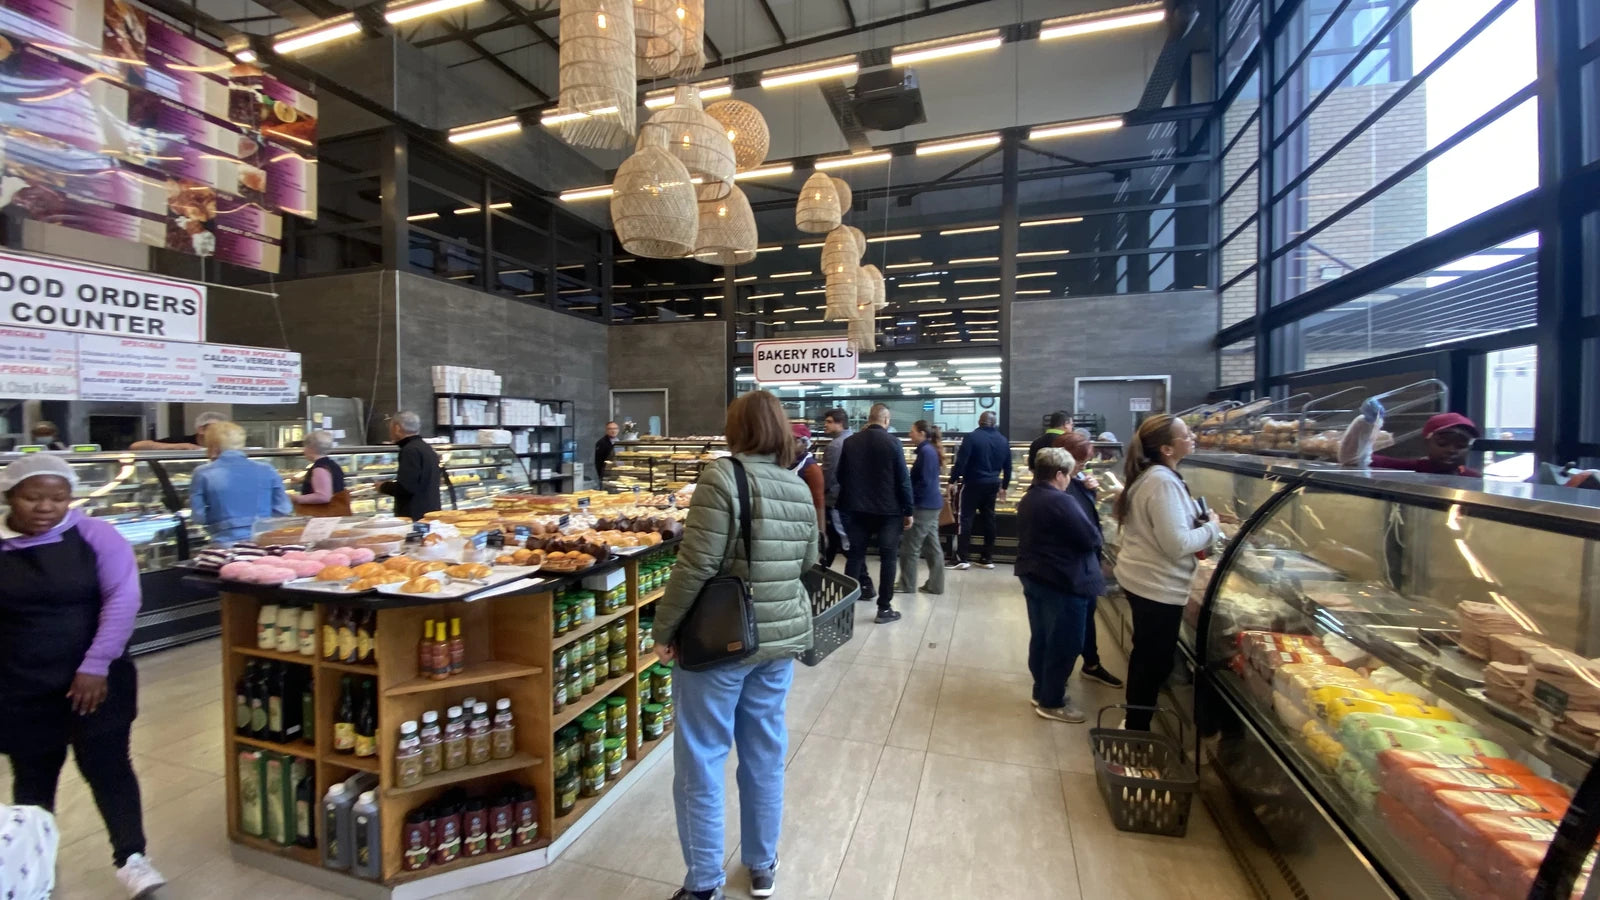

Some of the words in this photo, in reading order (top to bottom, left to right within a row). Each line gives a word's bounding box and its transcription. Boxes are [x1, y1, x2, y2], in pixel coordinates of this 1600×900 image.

[78, 284, 197, 316] ORDERS
[12, 302, 166, 336] COUNTER
[220, 348, 250, 356] WINTER
[758, 349, 808, 361] BAKERY
[812, 347, 854, 359] ROLLS
[203, 354, 237, 363] CALDO
[245, 357, 274, 365] VERDE
[277, 359, 300, 367] SOUP
[774, 362, 835, 374] COUNTER
